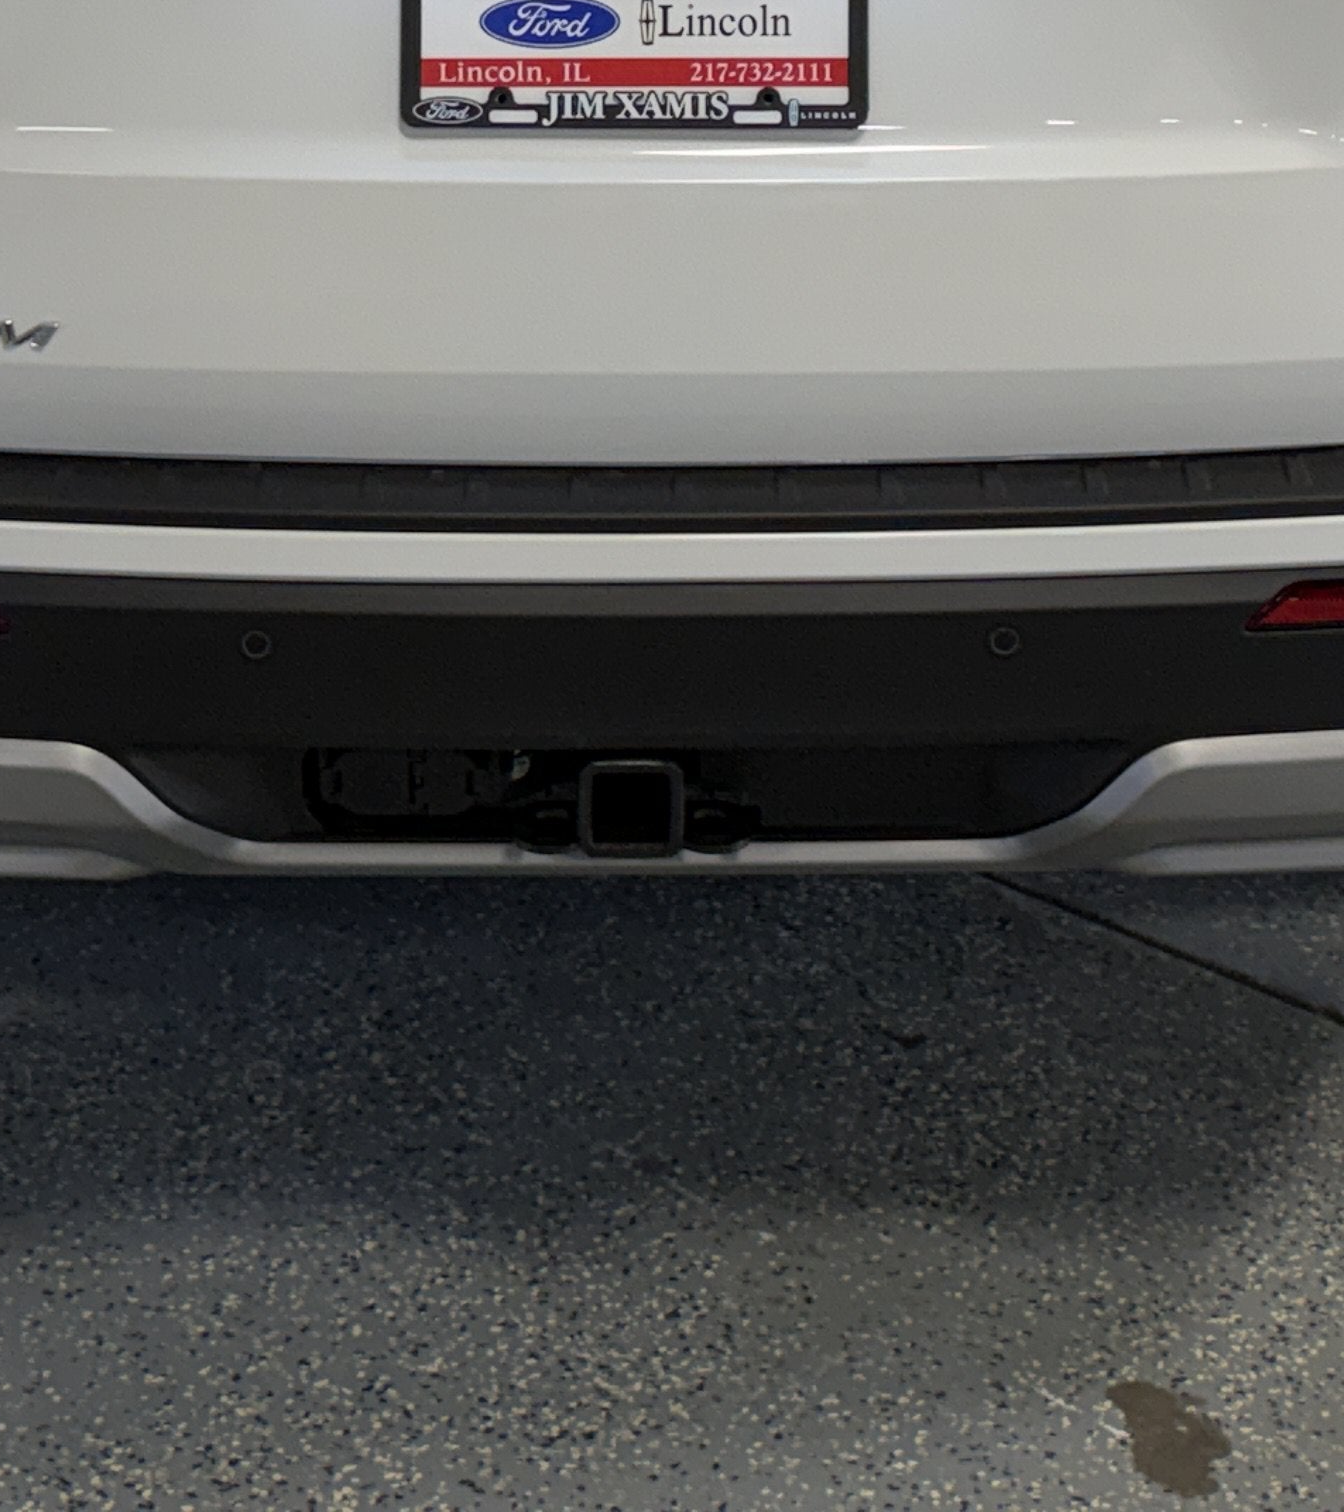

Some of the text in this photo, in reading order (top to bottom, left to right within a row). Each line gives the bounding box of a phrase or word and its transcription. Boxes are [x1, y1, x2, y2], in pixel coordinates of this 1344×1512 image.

[508, 4, 590, 39] Ford
[659, 4, 792, 37] Lincoln
[439, 61, 590, 85] Lincoln, IL
[690, 62, 833, 83] 217-732-2111
[426, 101, 470, 120] Ford
[543, 91, 729, 126] JIM XAMIS
